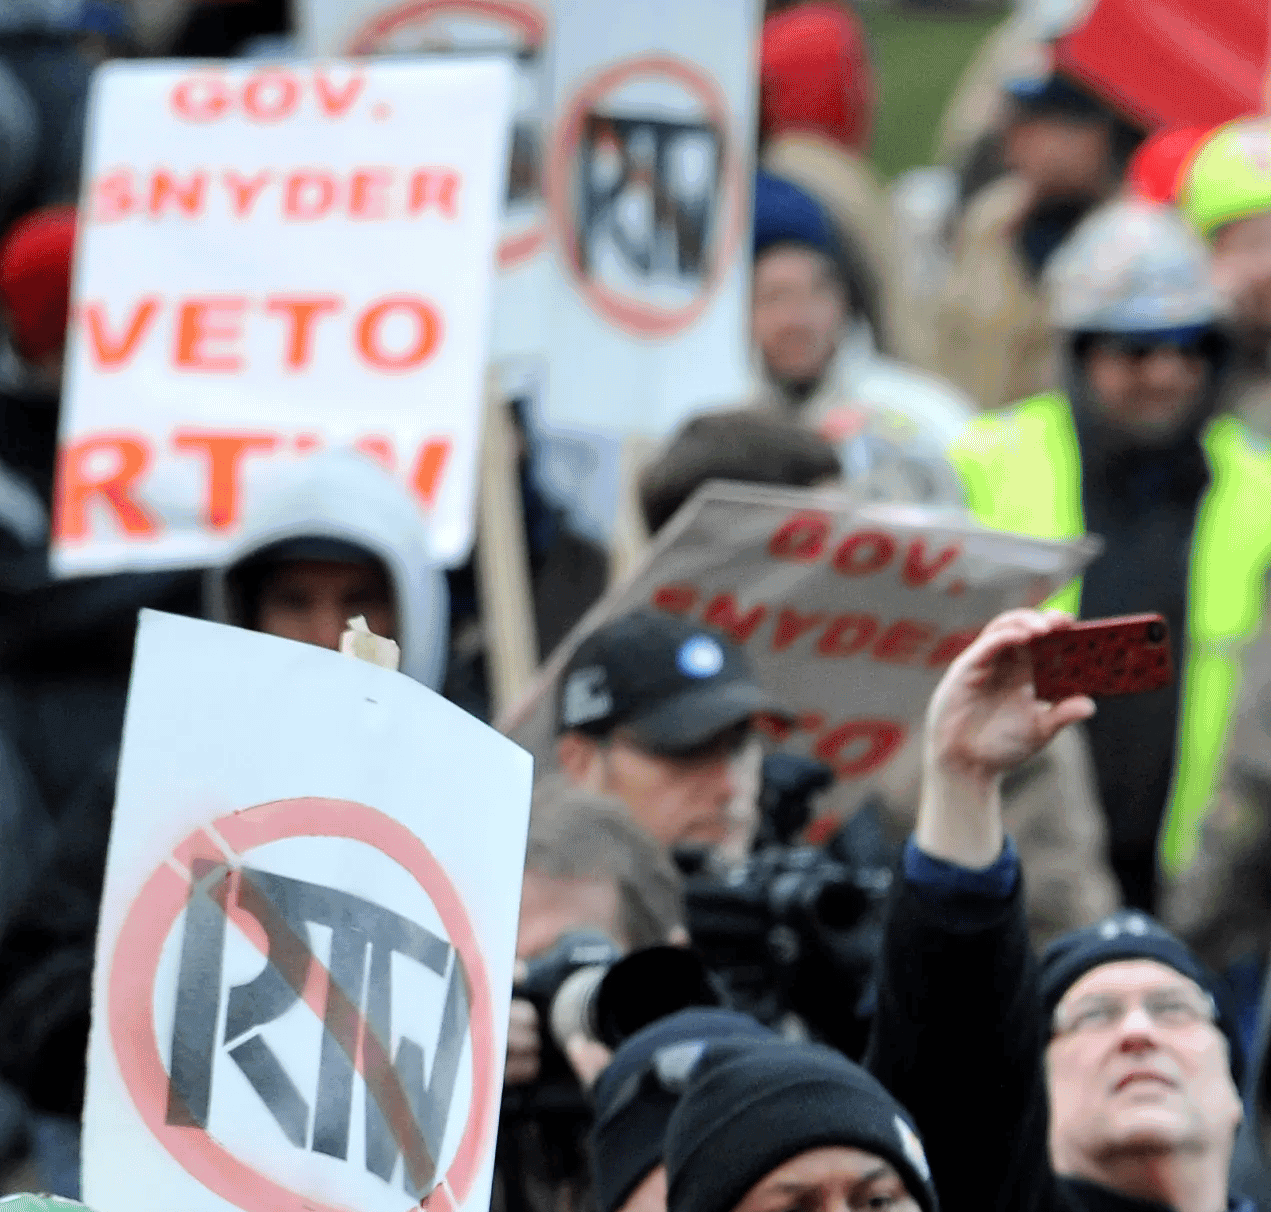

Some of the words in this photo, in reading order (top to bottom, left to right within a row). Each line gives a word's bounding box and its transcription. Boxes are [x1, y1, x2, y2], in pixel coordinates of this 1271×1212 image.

[171, 67, 391, 122] GOV.
[92, 167, 462, 222] SNYDER
[82, 297, 444, 372] VETO
[166, 857, 471, 1199] RTW
